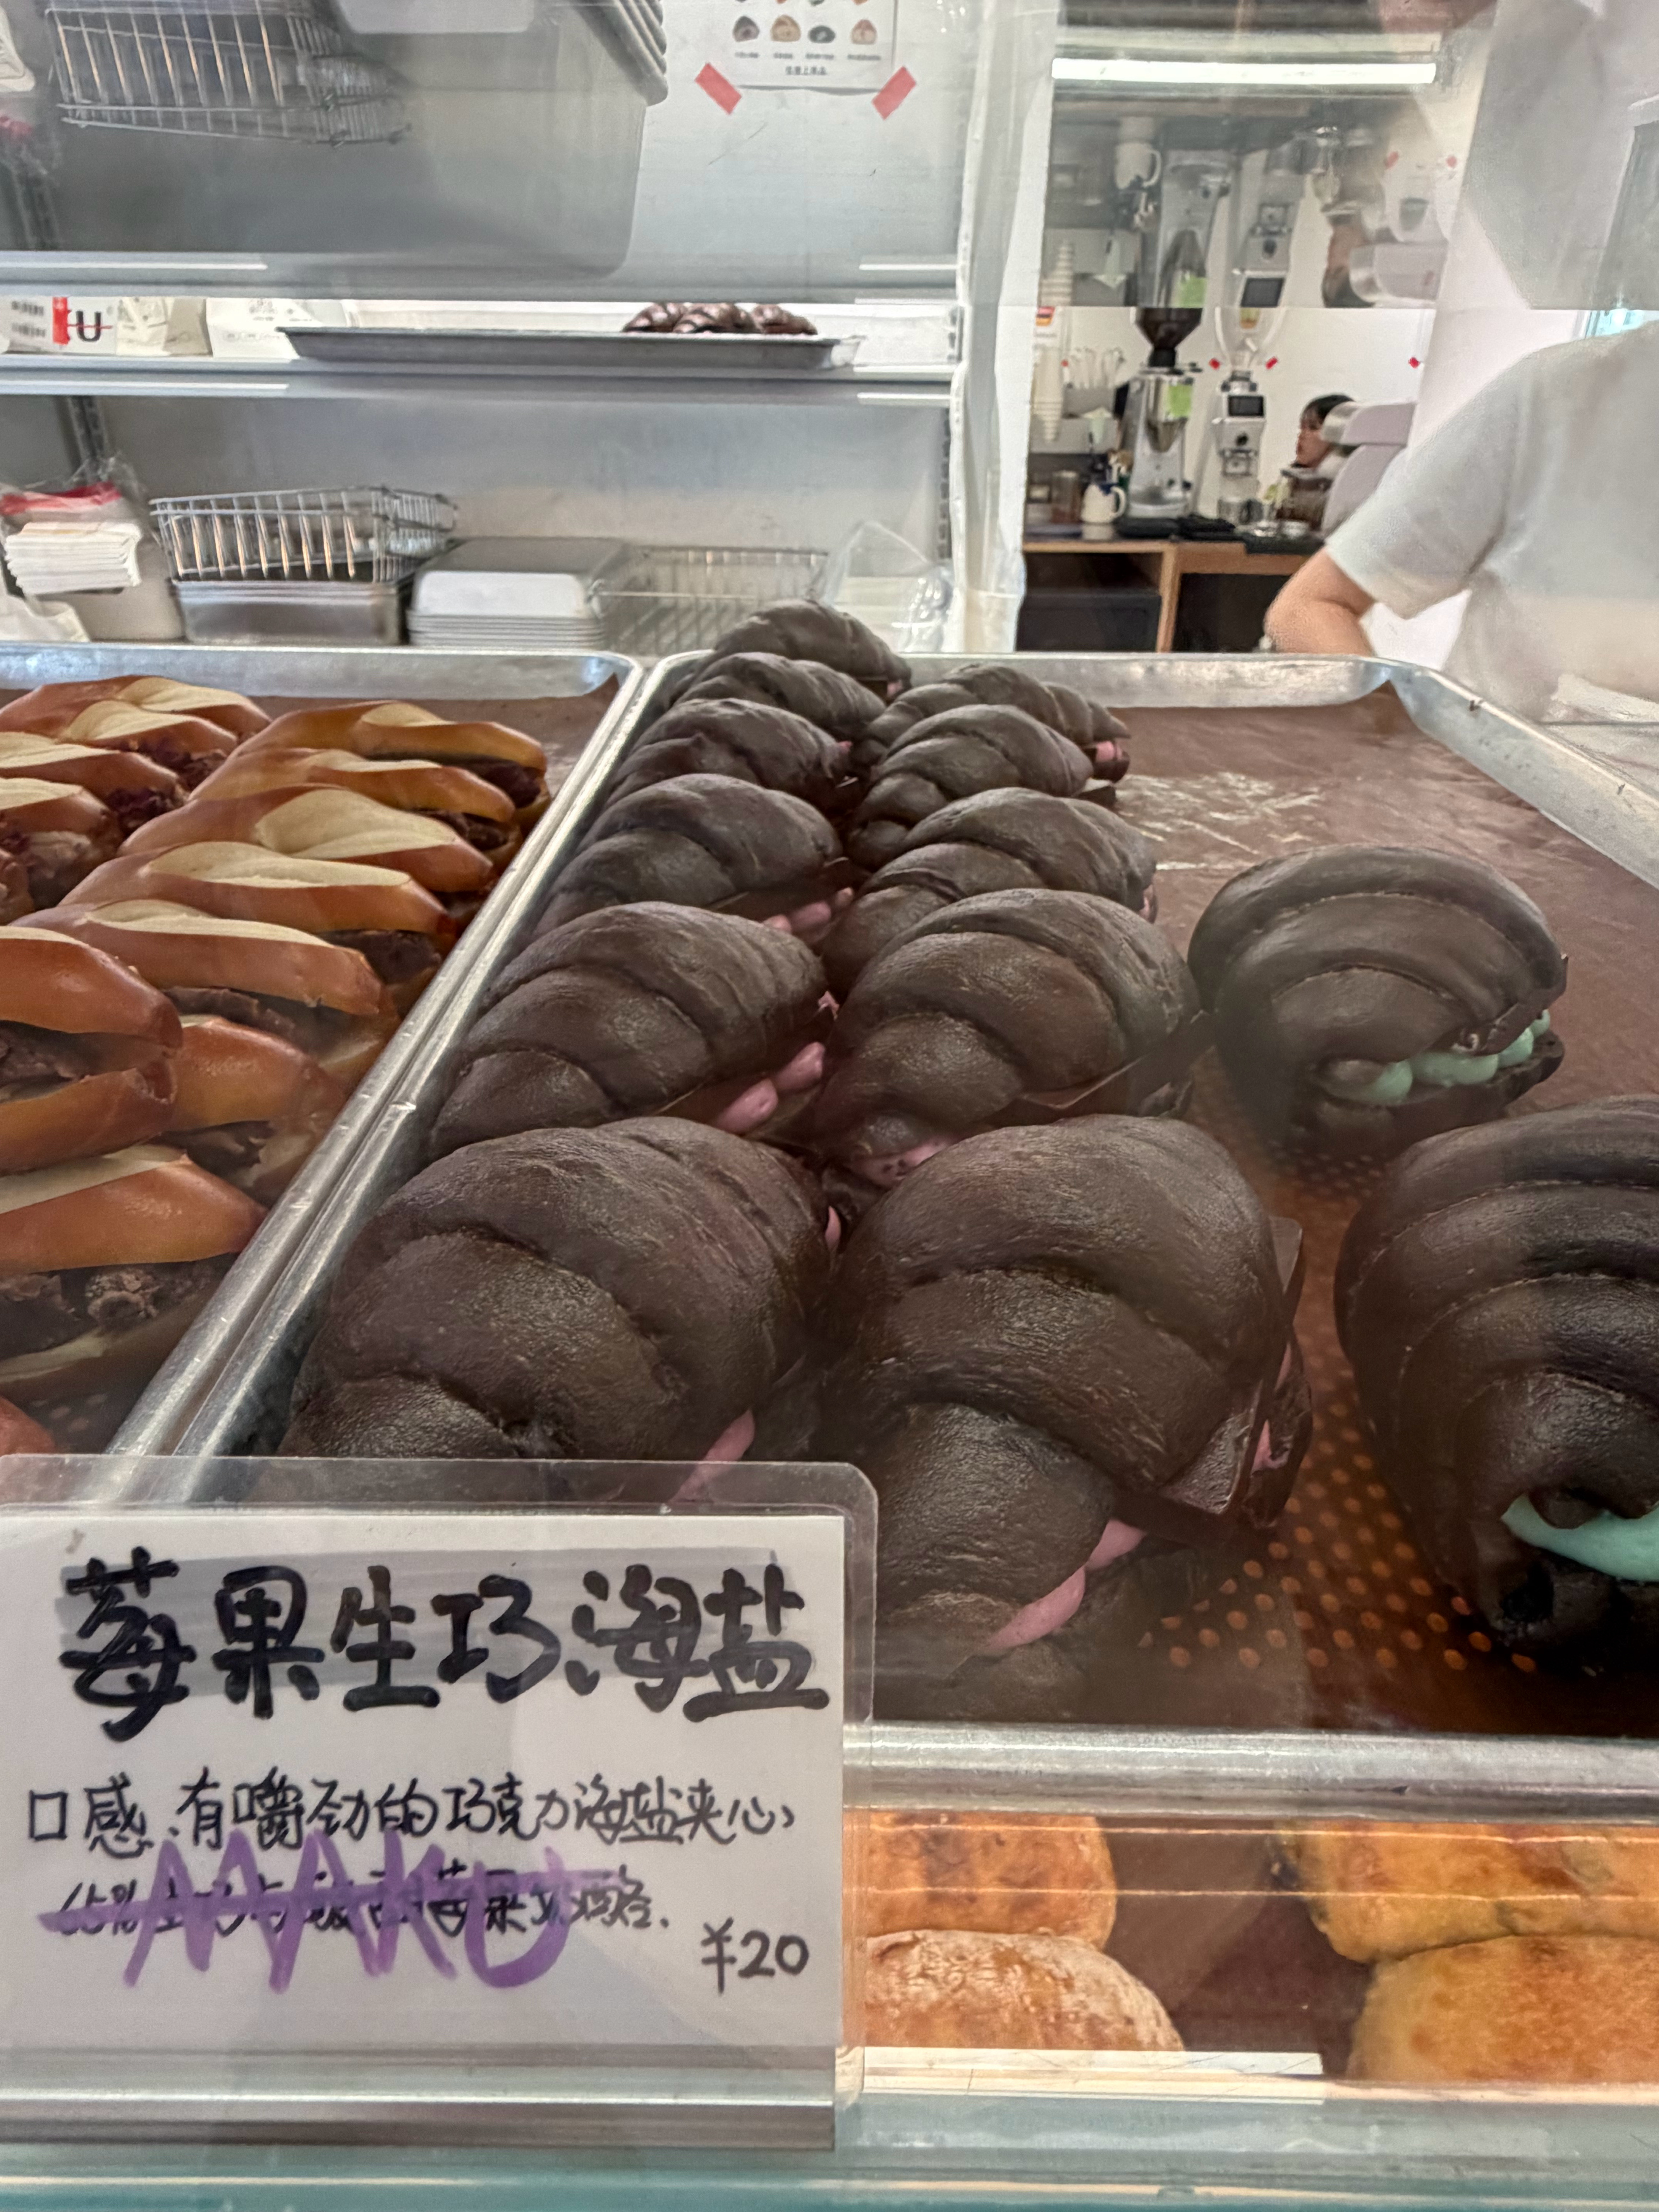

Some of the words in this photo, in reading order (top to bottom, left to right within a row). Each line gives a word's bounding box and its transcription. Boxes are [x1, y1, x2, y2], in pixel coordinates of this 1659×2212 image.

[60, 1547, 830, 1742] 莓果生巧海盐
[701, 1917, 809, 1995] ¥20
